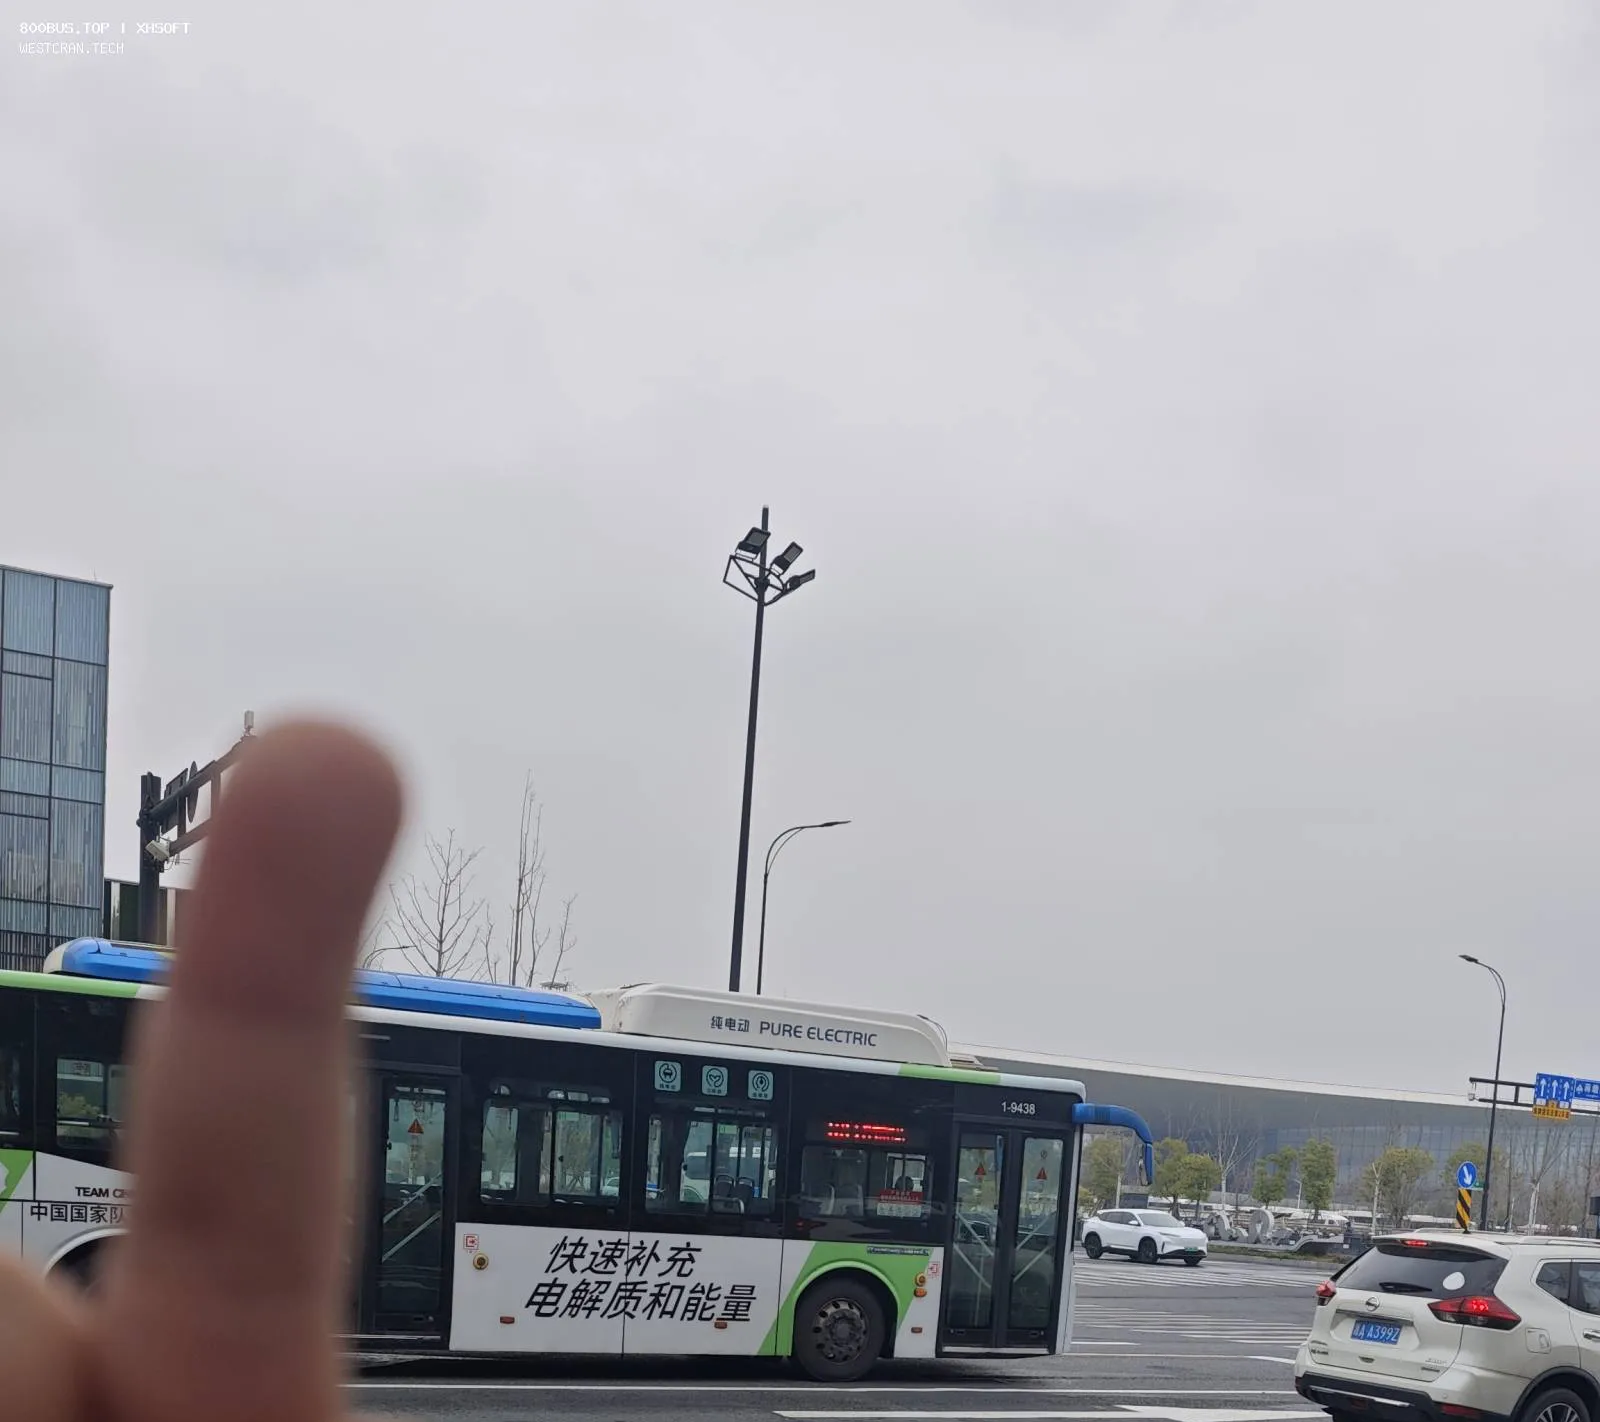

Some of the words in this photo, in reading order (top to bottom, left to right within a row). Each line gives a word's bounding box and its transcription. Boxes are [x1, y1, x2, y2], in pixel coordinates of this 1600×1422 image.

[711, 1015, 750, 1033] 纯电动
[760, 1021, 803, 1039] PURE
[807, 1026, 878, 1047] ELECTRIC
[1001, 1101, 1036, 1114] 1-9438
[75, 1186, 109, 1198] TEAM
[545, 1235, 702, 1278] 快速补充
[524, 1277, 757, 1322] 电解质和能量
